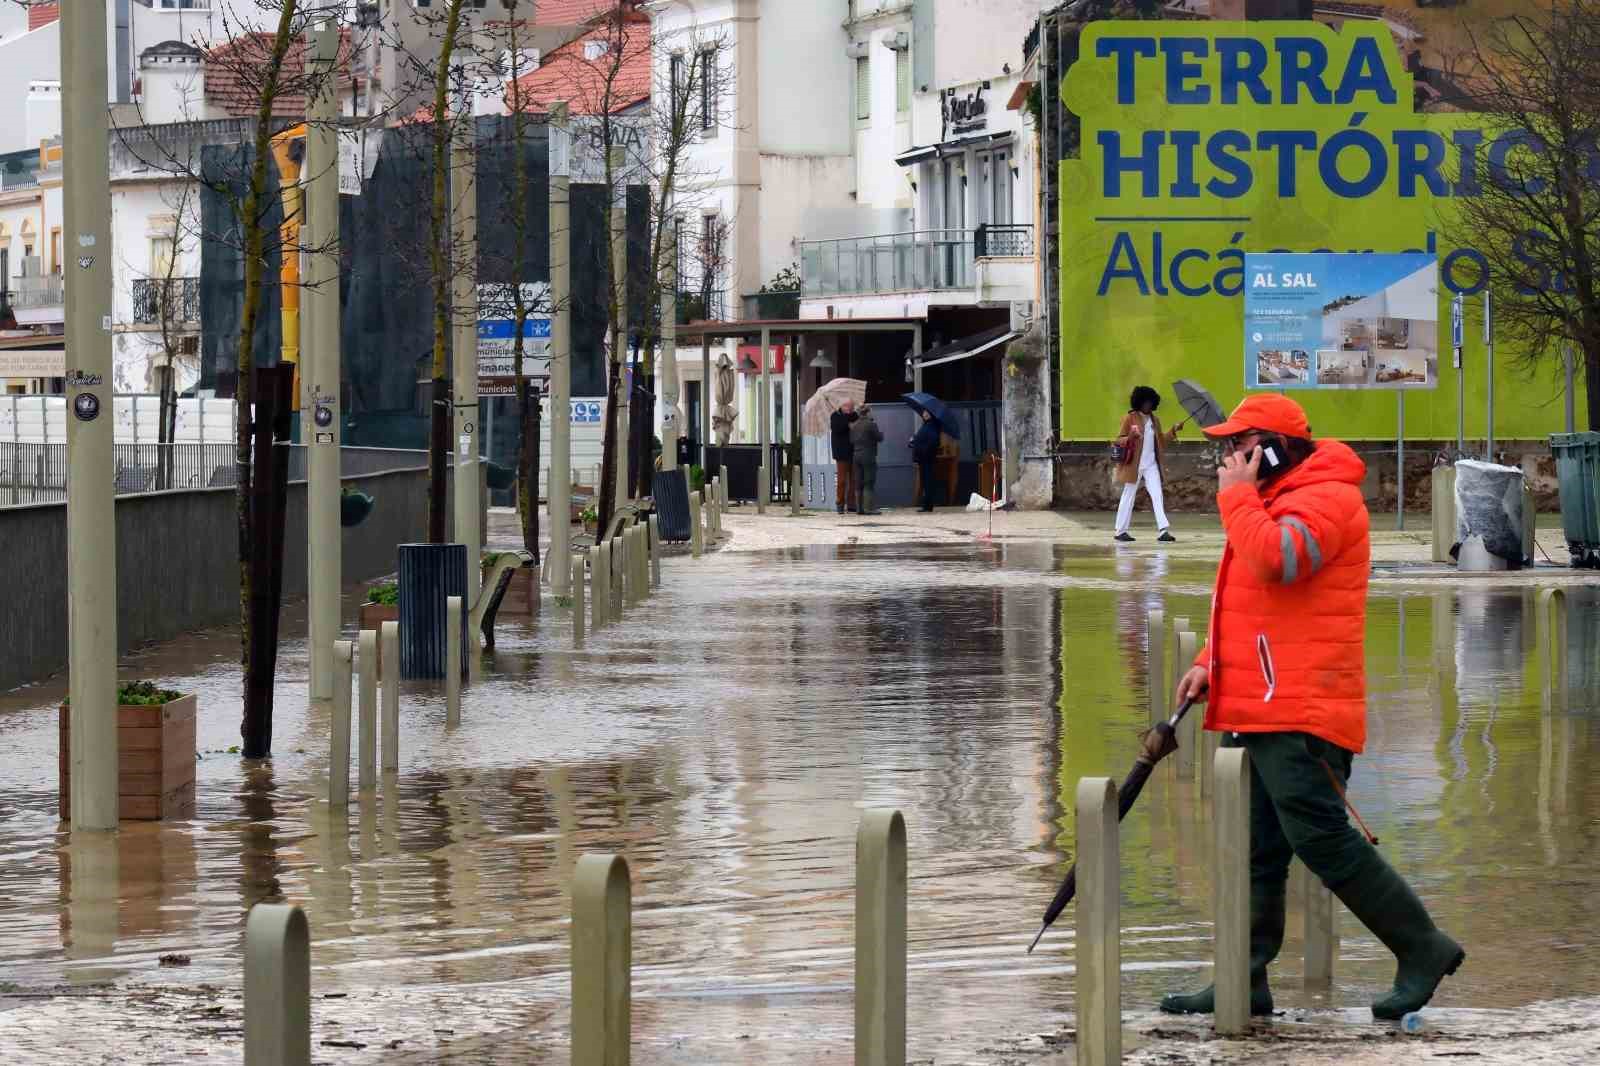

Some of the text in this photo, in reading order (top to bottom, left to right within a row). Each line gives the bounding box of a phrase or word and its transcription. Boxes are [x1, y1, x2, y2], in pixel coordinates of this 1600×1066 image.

[1096, 38, 1397, 104] TERRA
[1253, 272, 1317, 288] AL SAL
